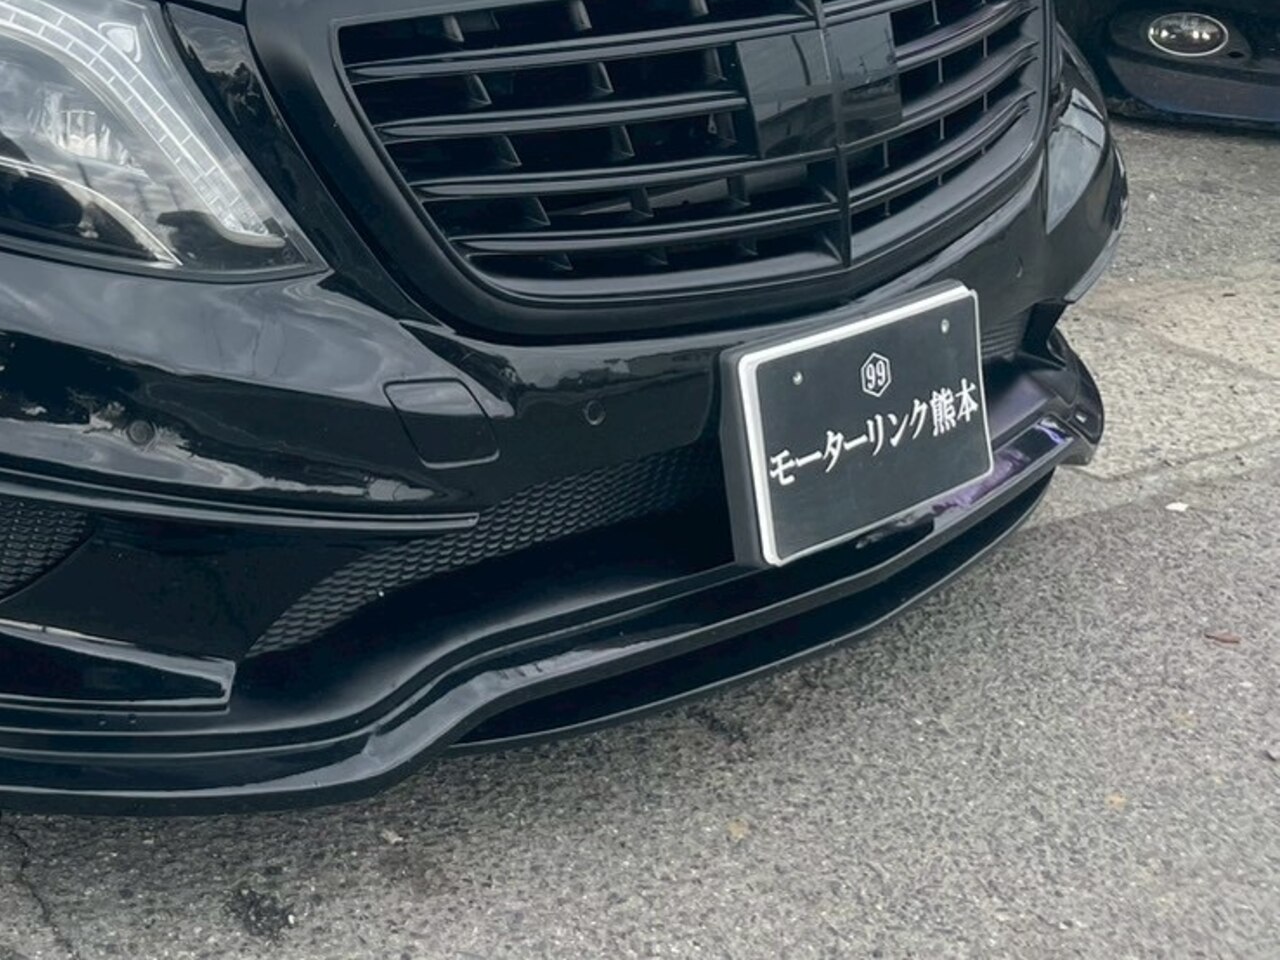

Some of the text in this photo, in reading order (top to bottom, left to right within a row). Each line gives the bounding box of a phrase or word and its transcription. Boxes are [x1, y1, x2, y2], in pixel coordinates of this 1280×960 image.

[865, 359, 887, 390] 99
[769, 377, 980, 487] モーターリンク熊本
